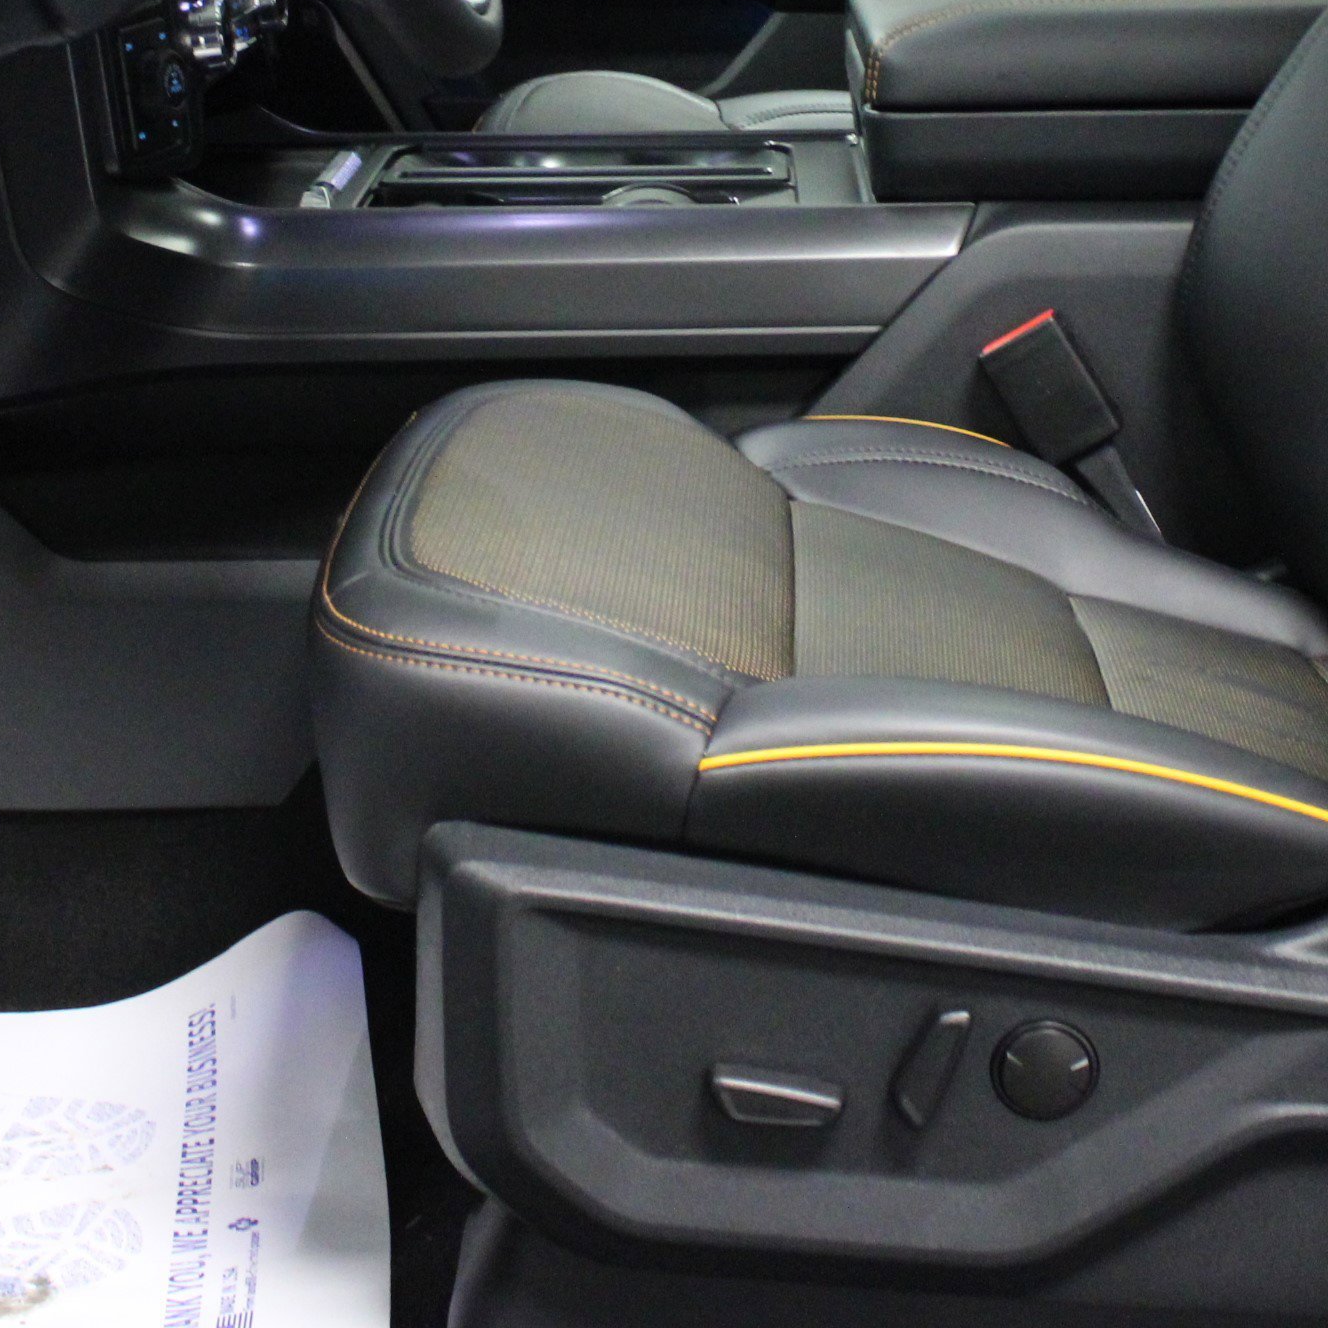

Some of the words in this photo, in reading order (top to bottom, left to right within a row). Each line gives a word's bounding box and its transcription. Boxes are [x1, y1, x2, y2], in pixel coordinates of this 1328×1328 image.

[186, 1002, 218, 1093] BUSINESS!
[182, 1092, 218, 1139] YOUR
[174, 1137, 216, 1225] APPRECIATE
[171, 1229, 209, 1254] WE
[167, 1254, 212, 1294] YOU,
